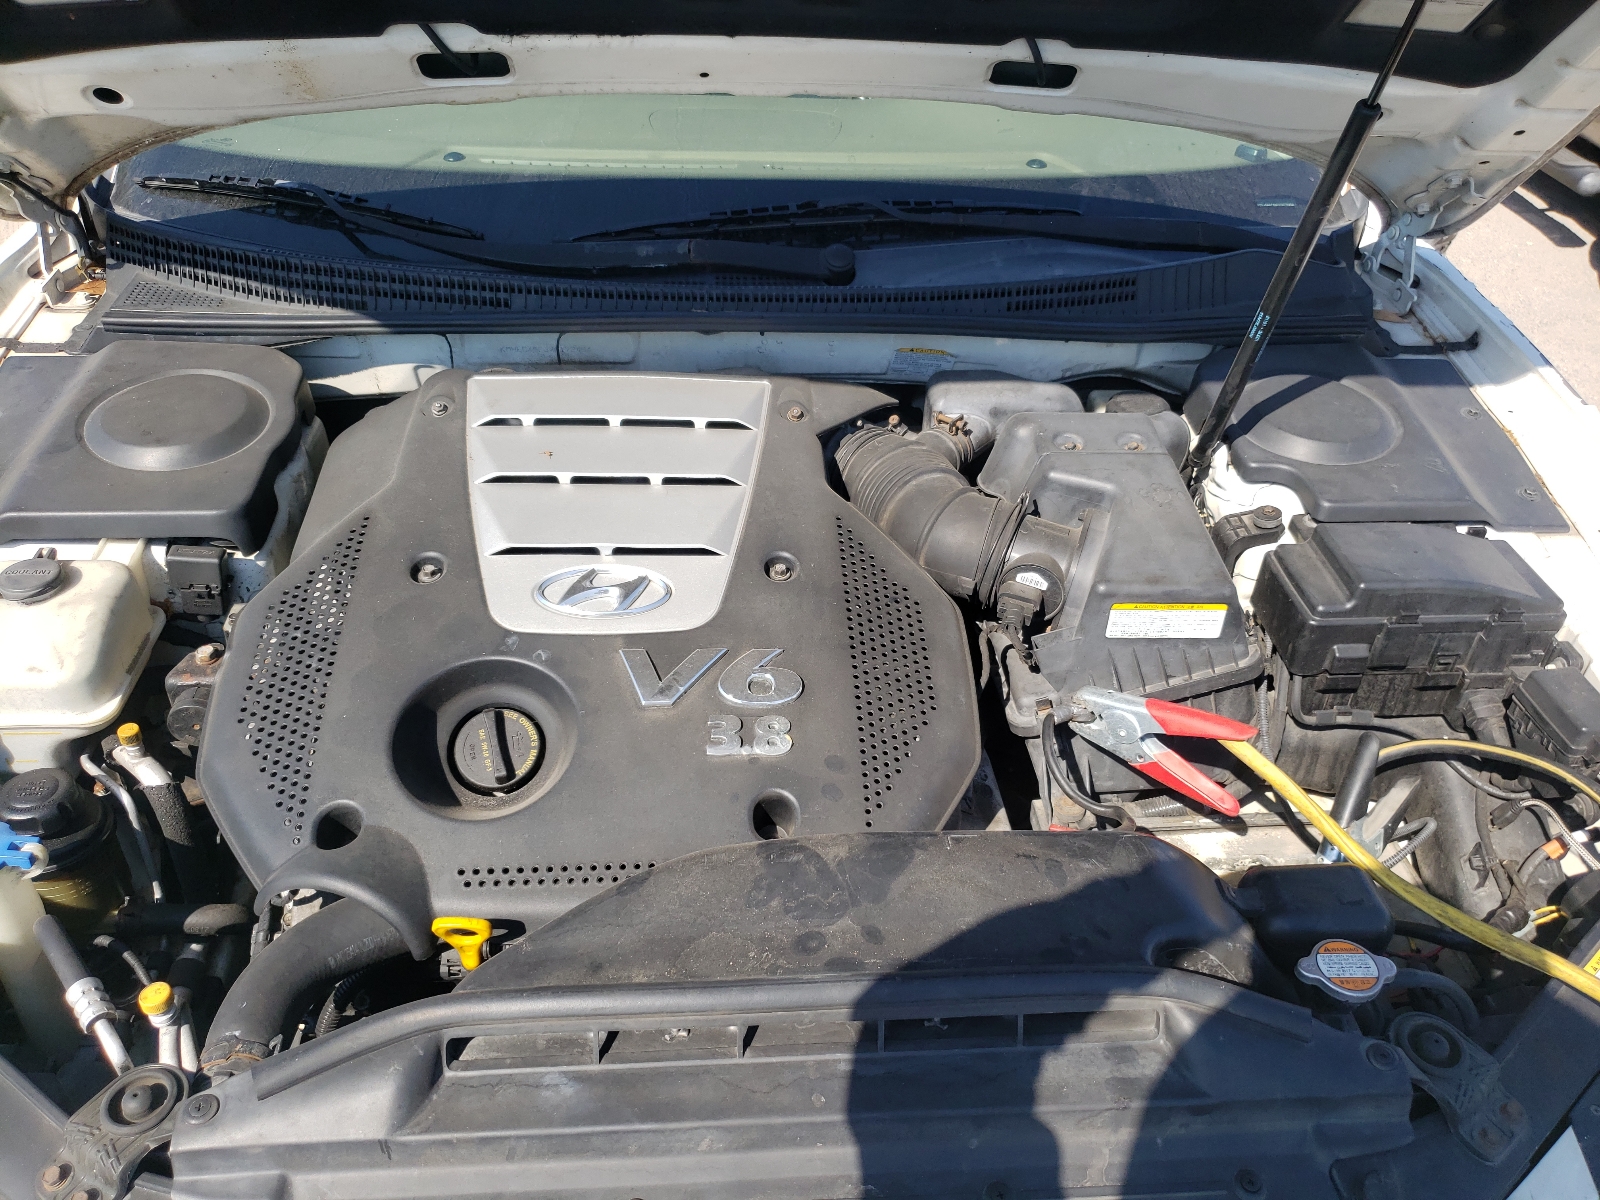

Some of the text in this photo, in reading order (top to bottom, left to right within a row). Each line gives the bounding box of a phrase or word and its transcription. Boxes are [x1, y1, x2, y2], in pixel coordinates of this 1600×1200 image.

[619, 648, 805, 707] V6
[503, 710, 538, 777] SEE OWNER'S MANUAL
[706, 714, 793, 756] 3.8
